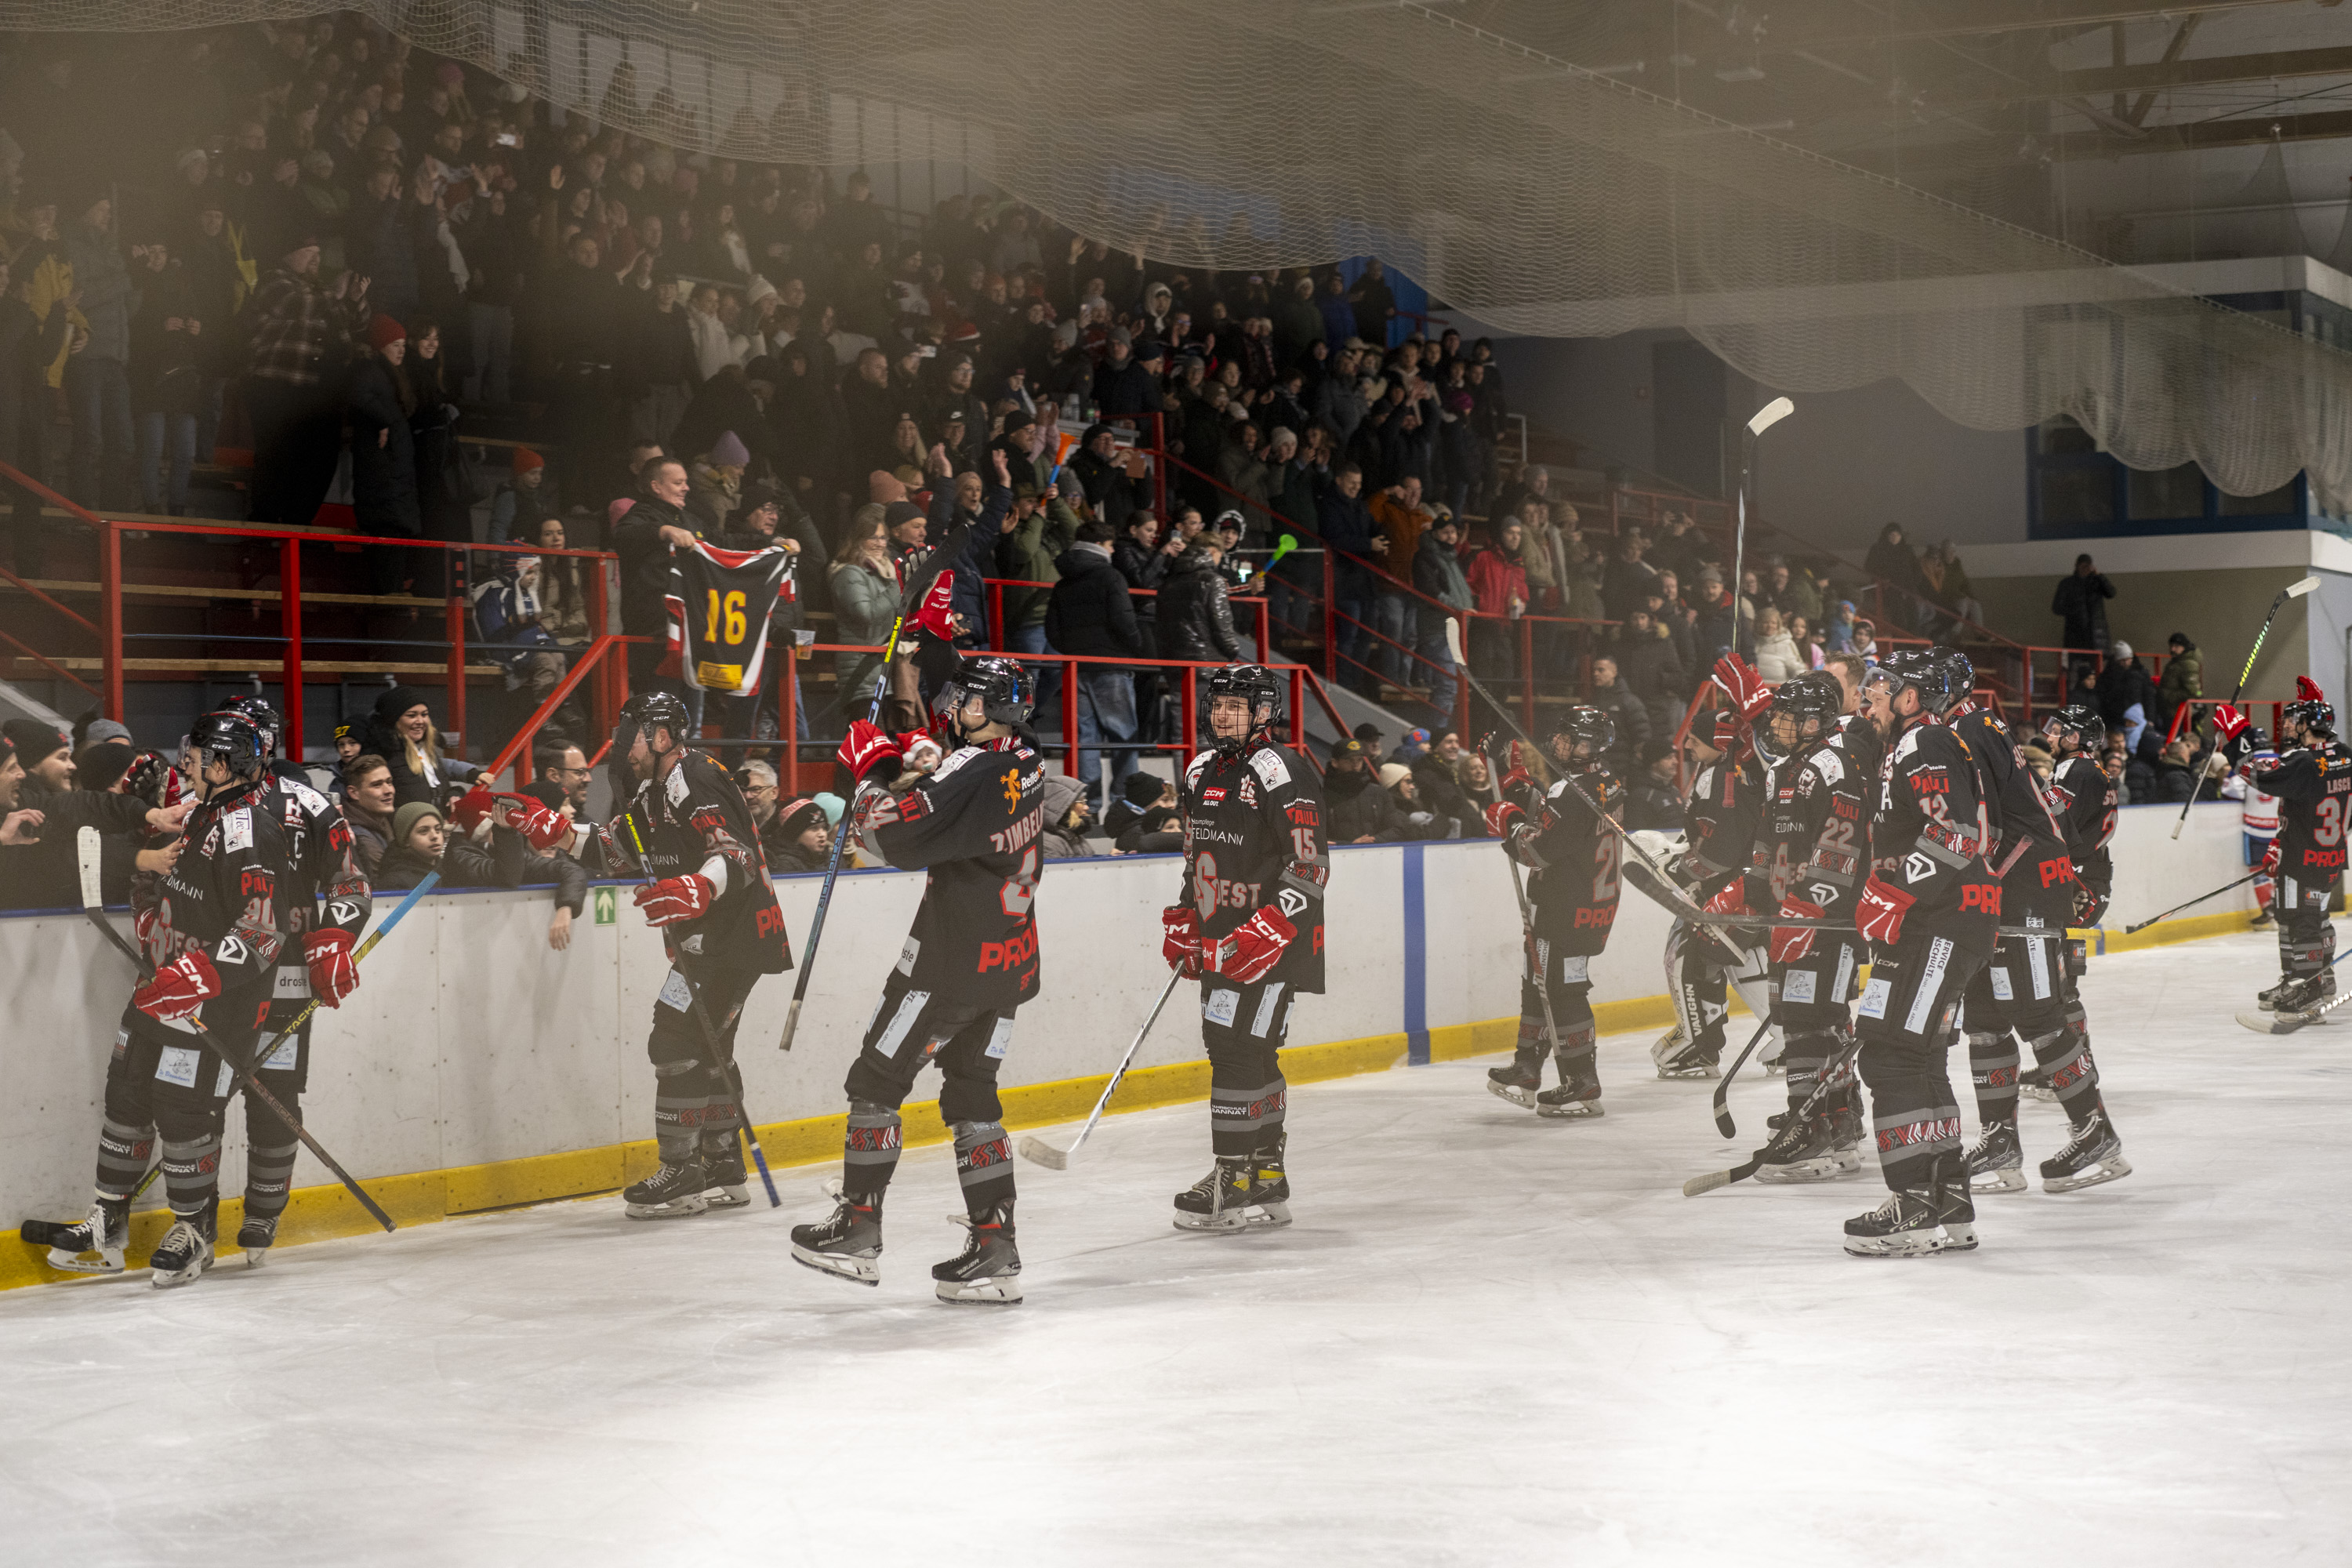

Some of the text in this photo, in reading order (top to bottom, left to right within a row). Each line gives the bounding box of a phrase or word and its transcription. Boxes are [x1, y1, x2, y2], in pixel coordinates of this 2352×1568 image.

[704, 588, 747, 646] 16
[1203, 789, 1225, 798] CCM
[1882, 781, 1893, 811] A
[1918, 793, 1953, 829] 12
[1192, 827, 1244, 847] FELDMANN
[1290, 827, 1318, 862] 15
[1818, 816, 1855, 853] 22
[236, 895, 277, 933] 90
[1250, 911, 1290, 949] CCM
[1877, 959, 1900, 969] CCM
[1936, 940, 1951, 971] ERVICE
[284, 998, 321, 1034] TACKS
[1685, 983, 1703, 1037] VAUGHN
[1914, 990, 1924, 1011] MICHAEL
[1907, 1012, 1916, 1029] ARNDT
[817, 1235, 844, 1247] BAUER
[956, 1258, 980, 1276] BAUER
